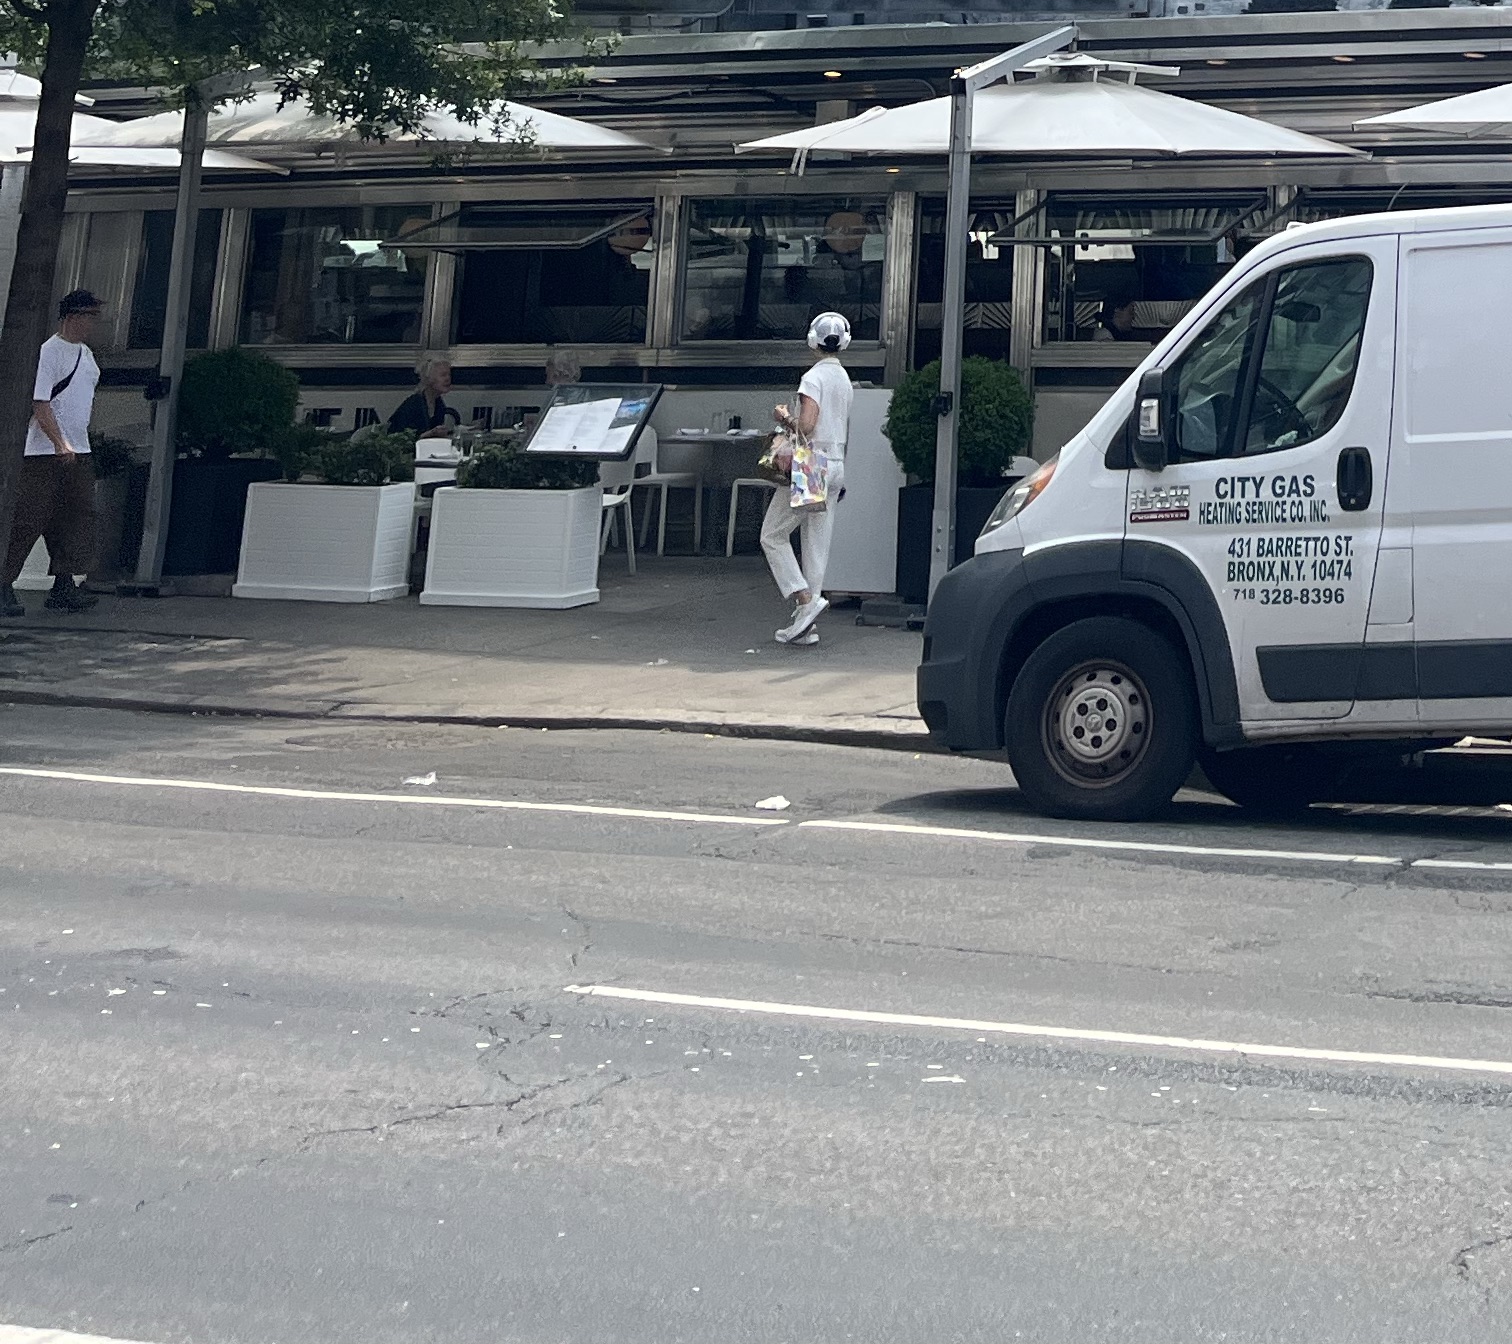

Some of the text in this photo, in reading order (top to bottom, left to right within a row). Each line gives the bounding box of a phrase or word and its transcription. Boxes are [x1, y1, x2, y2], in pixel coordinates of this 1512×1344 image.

[1215, 474, 1315, 500] CITY GAS
[1198, 501, 1242, 525] HEATING
[1245, 499, 1287, 523] SERVICE
[1309, 499, 1331, 522] INC.
[1228, 535, 1354, 558] 431 BARRETTO ST.
[1311, 559, 1352, 581] 10474
[1233, 587, 1345, 605] 718 328-8396
